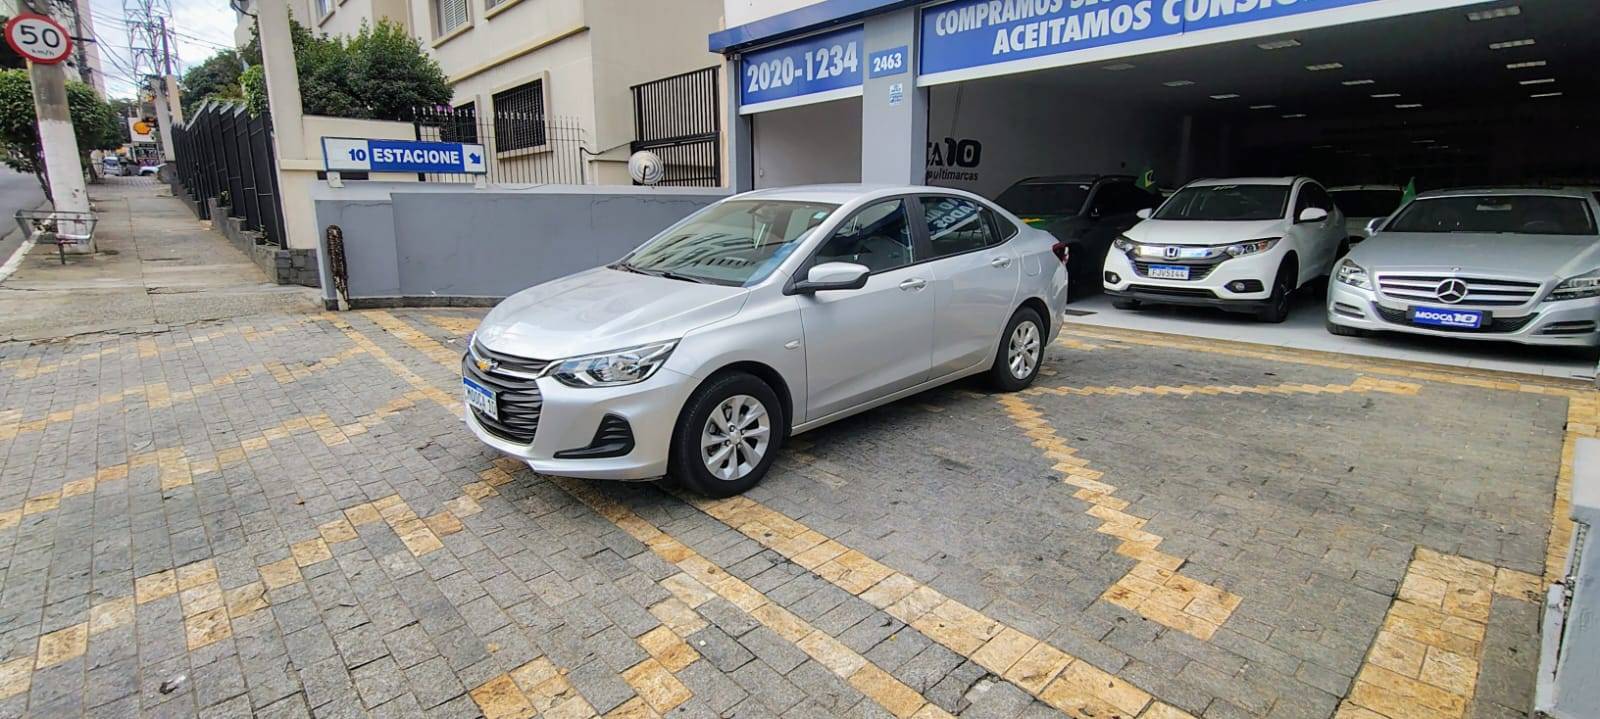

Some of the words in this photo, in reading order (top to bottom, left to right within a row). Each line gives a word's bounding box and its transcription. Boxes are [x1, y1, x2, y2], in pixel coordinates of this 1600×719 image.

[20, 25, 60, 48] 50
[992, 1, 1152, 55] ACEITAMOS
[747, 41, 858, 93] 2020-1234
[873, 52, 902, 72] 2463
[349, 149, 366, 161] 10
[373, 148, 460, 164] ESTACIONE
